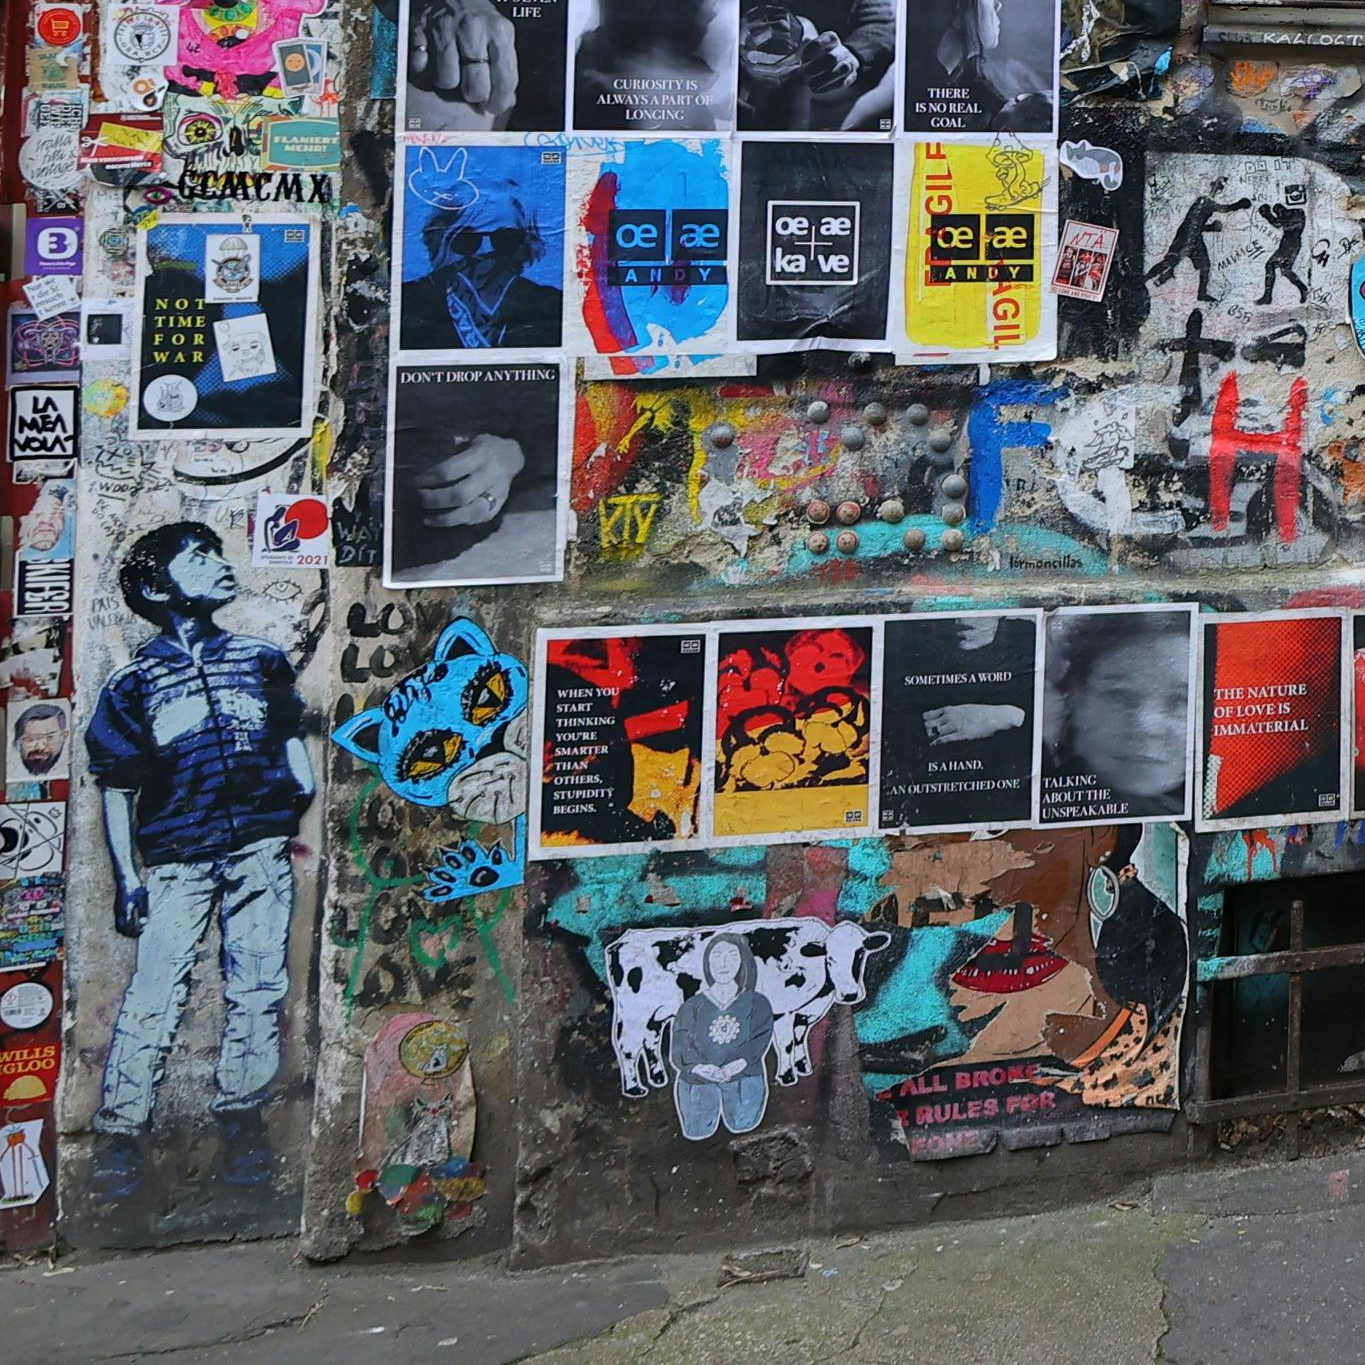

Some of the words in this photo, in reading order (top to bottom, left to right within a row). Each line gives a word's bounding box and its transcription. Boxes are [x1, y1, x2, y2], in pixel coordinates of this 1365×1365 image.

[512, 6, 542, 19] LIFE
[613, 78, 683, 91] CURIOSITY
[685, 79, 698, 91] IS
[596, 94, 648, 106] ALWAYS
[661, 95, 692, 106] PART
[927, 87, 970, 100] THERE
[625, 108, 684, 121] LONGING
[928, 102, 947, 114] NO
[948, 103, 983, 115] REAL
[929, 116, 967, 128] GOAL
[624, 267, 711, 285] ANDY
[945, 266, 1021, 281] ANDY
[154, 297, 206, 310] NOT
[154, 315, 207, 328] TIME
[153, 333, 206, 346] FOR
[153, 351, 205, 363] WAR
[400, 371, 445, 385] DON'T
[445, 370, 483, 384] DROP
[484, 368, 557, 383] ANYTHING
[32, 396, 59, 413] LA
[296, 554, 329, 566] 2021
[904, 673, 968, 686] SOMETIMES
[979, 671, 1012, 683] WORD
[557, 688, 594, 700] WHEN
[596, 686, 620, 698] YOU
[1213, 686, 1245, 701] THE
[1246, 683, 1307, 699] NATURE
[556, 702, 594, 713] START
[1213, 705, 1235, 719] OF
[1238, 703, 1276, 718] LOVE
[1278, 702, 1291, 716] IS
[555, 716, 616, 728] THINKING
[1213, 719, 1309, 737] IMMATERIAL
[555, 731, 598, 742] YOU'RE
[554, 744, 609, 757] SMARTER
[554, 760, 589, 772] THAN
[553, 774, 604, 787] OTHERS,
[909, 780, 997, 795] OUTSTRETCHED
[997, 779, 1021, 792] ONE
[1041, 774, 1097, 789] TALKING
[553, 787, 614, 802] STUPIDITY
[1041, 790, 1083, 804] ABOUT
[1084, 788, 1111, 802] THE
[552, 802, 597, 816] BEGINS.
[1040, 803, 1129, 820] UNSPEAKABLE
[900, 1075, 948, 1098] ALL
[954, 1065, 1040, 1091] BROKE
[916, 1097, 1000, 1126] RULES
[1005, 1091, 1056, 1113] FOR
